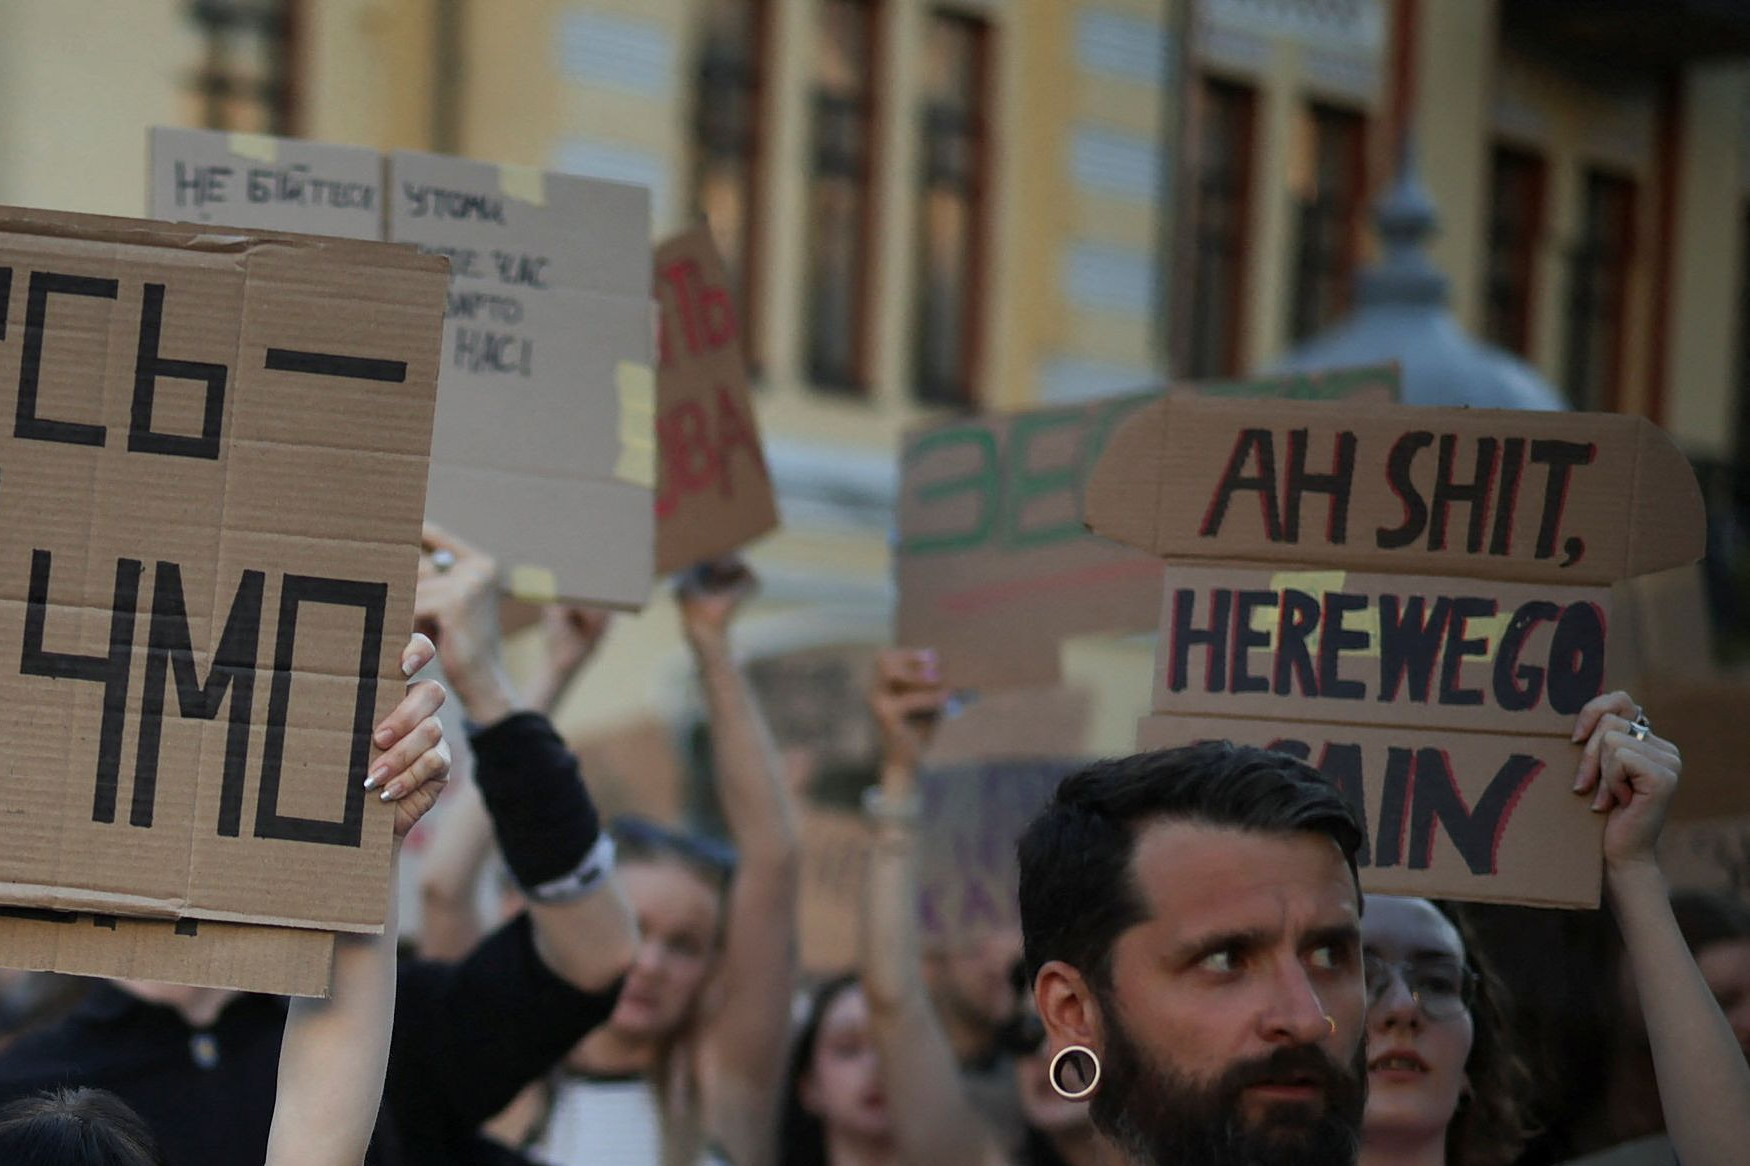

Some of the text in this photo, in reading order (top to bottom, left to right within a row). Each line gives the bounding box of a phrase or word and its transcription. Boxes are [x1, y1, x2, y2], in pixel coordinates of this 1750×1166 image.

[173, 159, 233, 208] НЕ
[1198, 427, 1357, 545] AH
[1376, 430, 1596, 567] SHIT,
[19, 548, 389, 848] ЧМО
